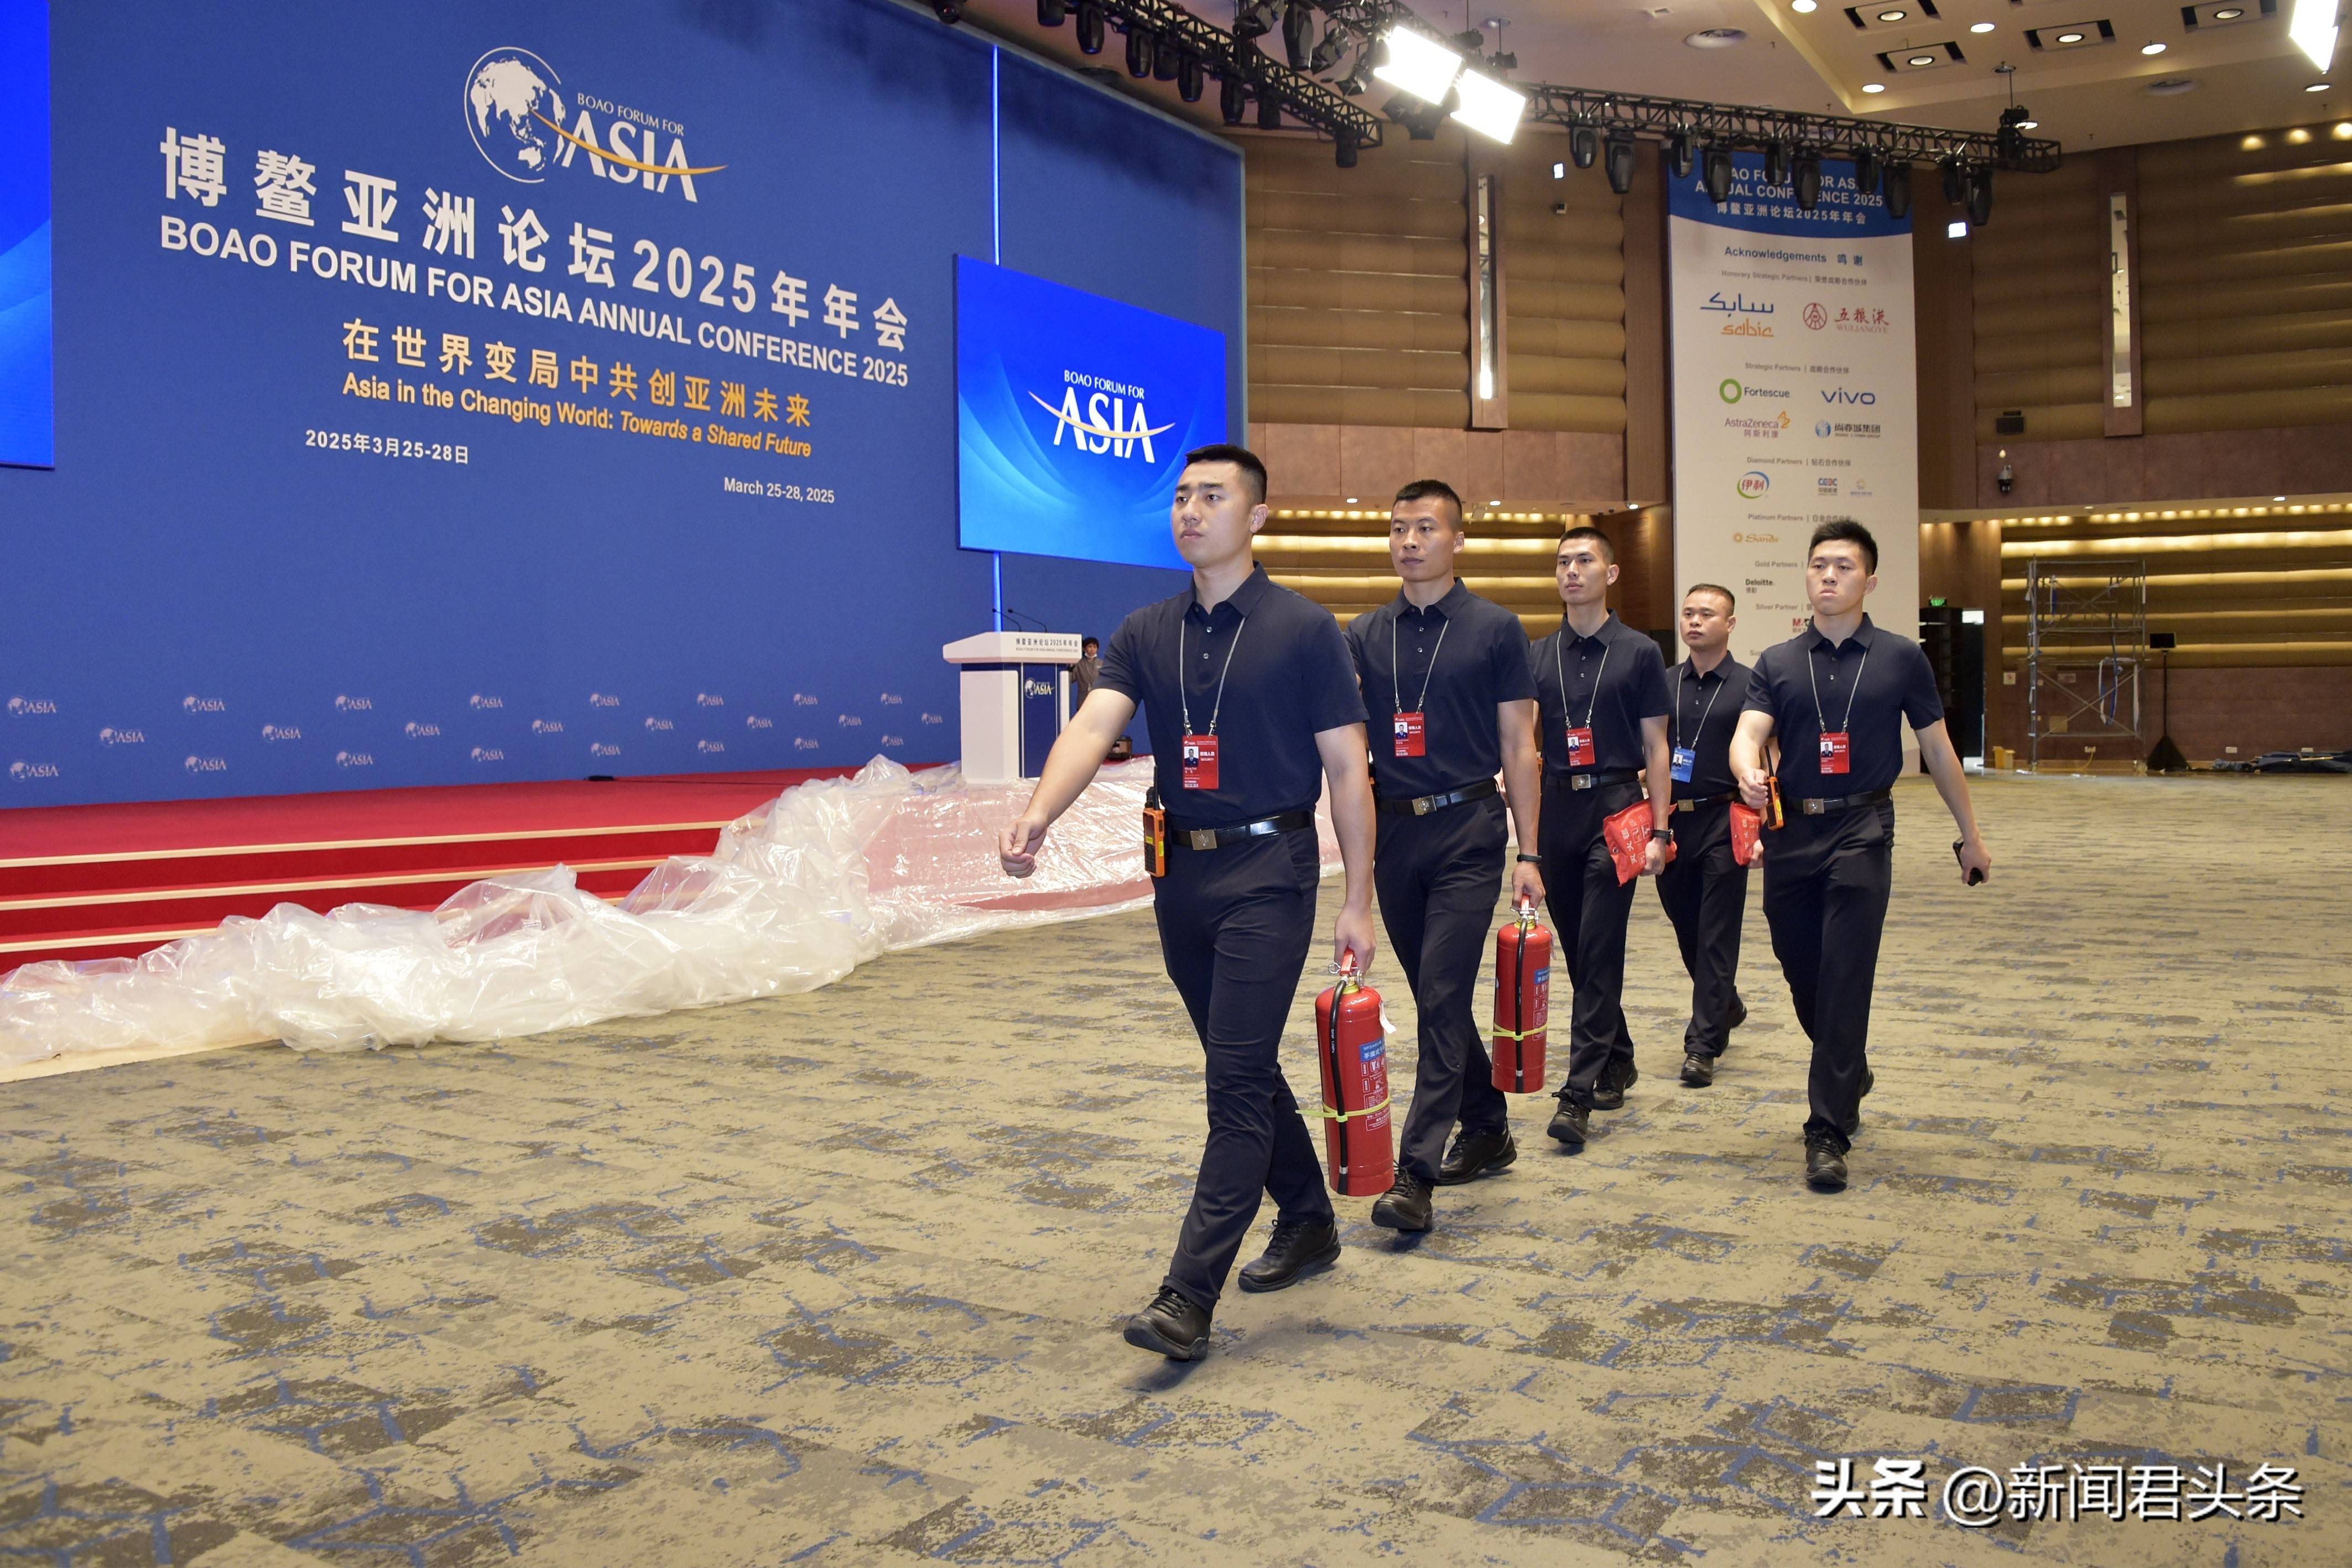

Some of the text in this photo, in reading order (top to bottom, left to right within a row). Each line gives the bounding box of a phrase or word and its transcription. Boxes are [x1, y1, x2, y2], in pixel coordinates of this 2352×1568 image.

[577, 92, 684, 137] BOAO FORUM FOR
[561, 110, 698, 202] ASIA
[1731, 168, 1749, 181] AO
[1757, 185, 1849, 204] CONFENCE
[1854, 194, 1883, 207] 2025
[1725, 246, 1827, 262] Acknowledgements
[1721, 269, 1750, 279] Honorary
[1752, 271, 1779, 281] Strategic
[1782, 273, 1808, 282] Partners
[162, 215, 908, 387] BOAO FORUM FOR ASIA ANNUAL CONFERENCE 2025
[1721, 318, 1775, 337] sabic
[1745, 362, 1773, 371] Strategic
[1064, 369, 1144, 399] BOAO FORUM FOR
[1744, 387, 1790, 398] Fortescue
[1821, 387, 1876, 405] vivo
[342, 372, 811, 457] Asia in the Changing World: Towards a Shared Future
[1053, 387, 1155, 463] ASIA
[1724, 417, 1779, 429] AstraZeneca
[1744, 429, 1779, 439] 阿斯利康
[305, 429, 469, 464] 2025年3月25-28日
[724, 477, 835, 503] March 25-28, 2025
[1741, 479, 1765, 491] 伊利
[1745, 534, 1779, 543] Sands
[1034, 684, 1052, 695] ASIA
[198, 699, 226, 711] ASIA
[349, 699, 372, 710] ASIA
[483, 697, 504, 708] ASIA
[601, 696, 620, 706] ASIA
[707, 696, 724, 705] ASIA
[803, 695, 818, 705] ASIA
[888, 695, 903, 704] ASIA
[27, 701, 57, 713] ASIA
[756, 719, 772, 728] ASIA
[847, 717, 862, 726] ASIA
[929, 715, 943, 723] ASIA
[418, 726, 440, 736] ASIA
[543, 722, 564, 732] ASIA
[655, 721, 673, 730] ASIA
[116, 731, 145, 743] ASIA
[277, 728, 301, 739] ASIA
[803, 739, 819, 748] ASIA
[889, 737, 903, 746] ASIA
[602, 746, 620, 756] ASIA
[707, 743, 724, 752] ASIA
[350, 754, 373, 765] ASIA
[483, 750, 504, 760] ASIA
[200, 759, 227, 770] ASIA
[28, 765, 59, 777] ASIA
